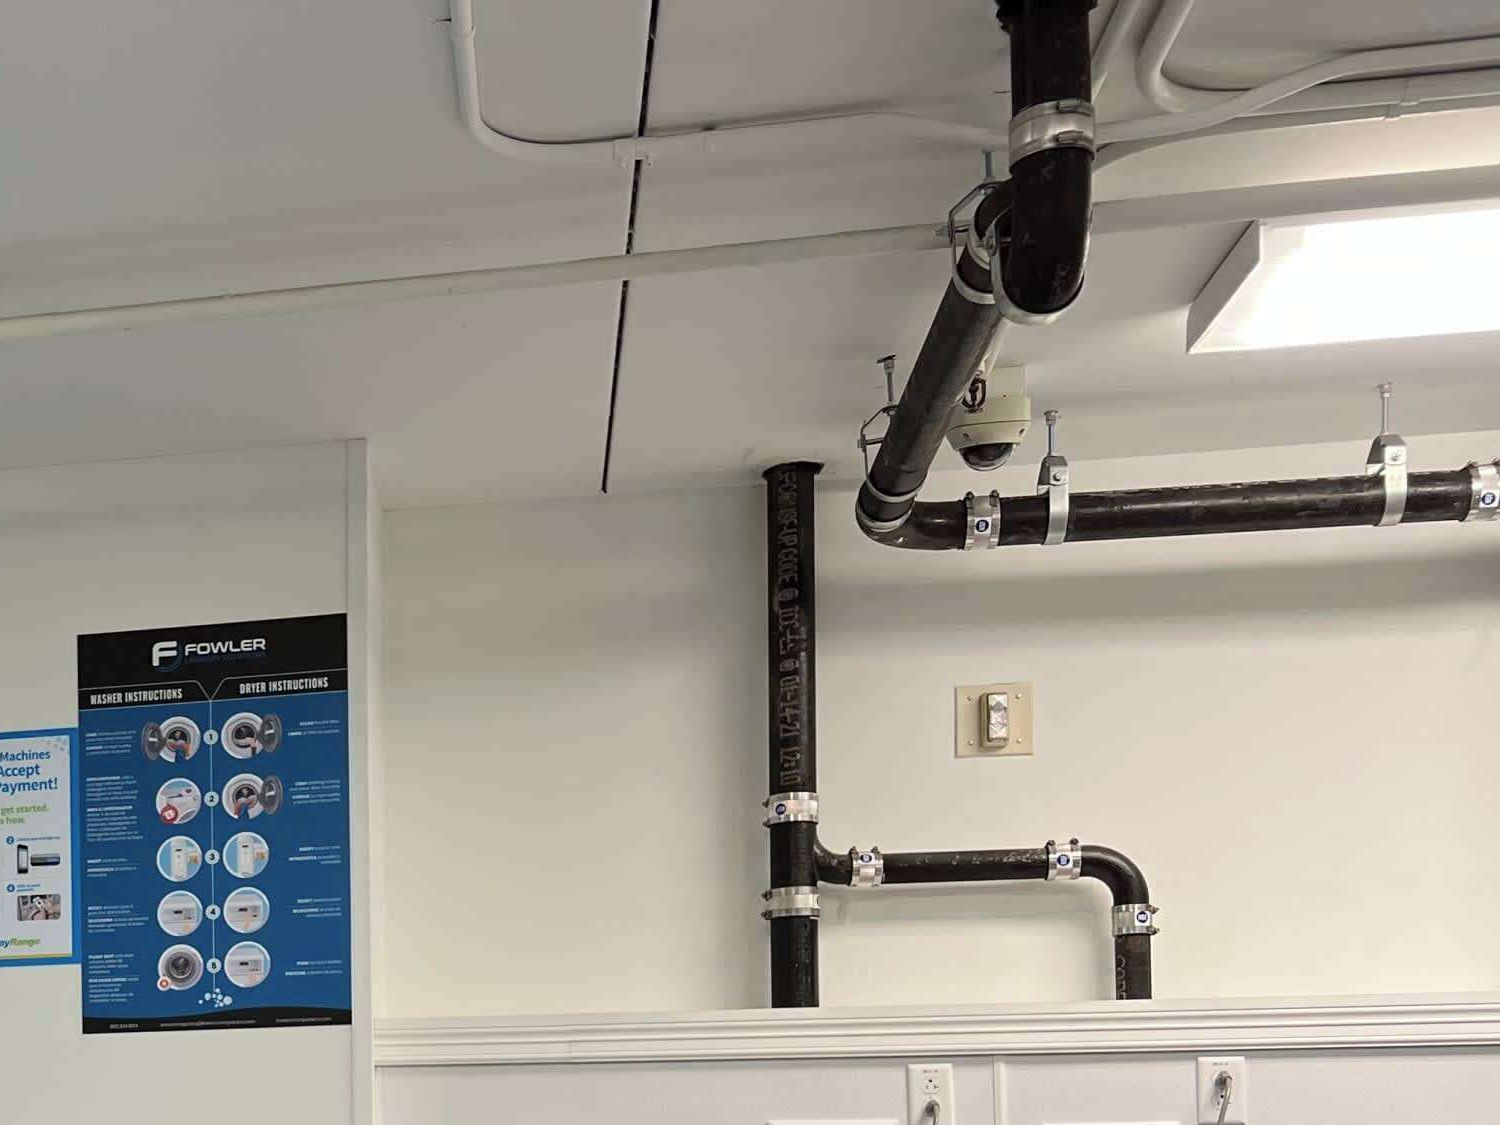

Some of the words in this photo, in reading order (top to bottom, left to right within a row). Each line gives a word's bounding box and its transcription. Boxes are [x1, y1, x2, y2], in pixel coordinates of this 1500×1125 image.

[184, 638, 266, 656] FOWLER
[239, 681, 266, 694] DRYER
[269, 677, 329, 691] INSTRUCTIONS
[90, 692, 123, 705] WASHER
[125, 688, 183, 702] INSTRUCTIONS
[0, 750, 51, 762] Machines
[1, 806, 15, 817] get
